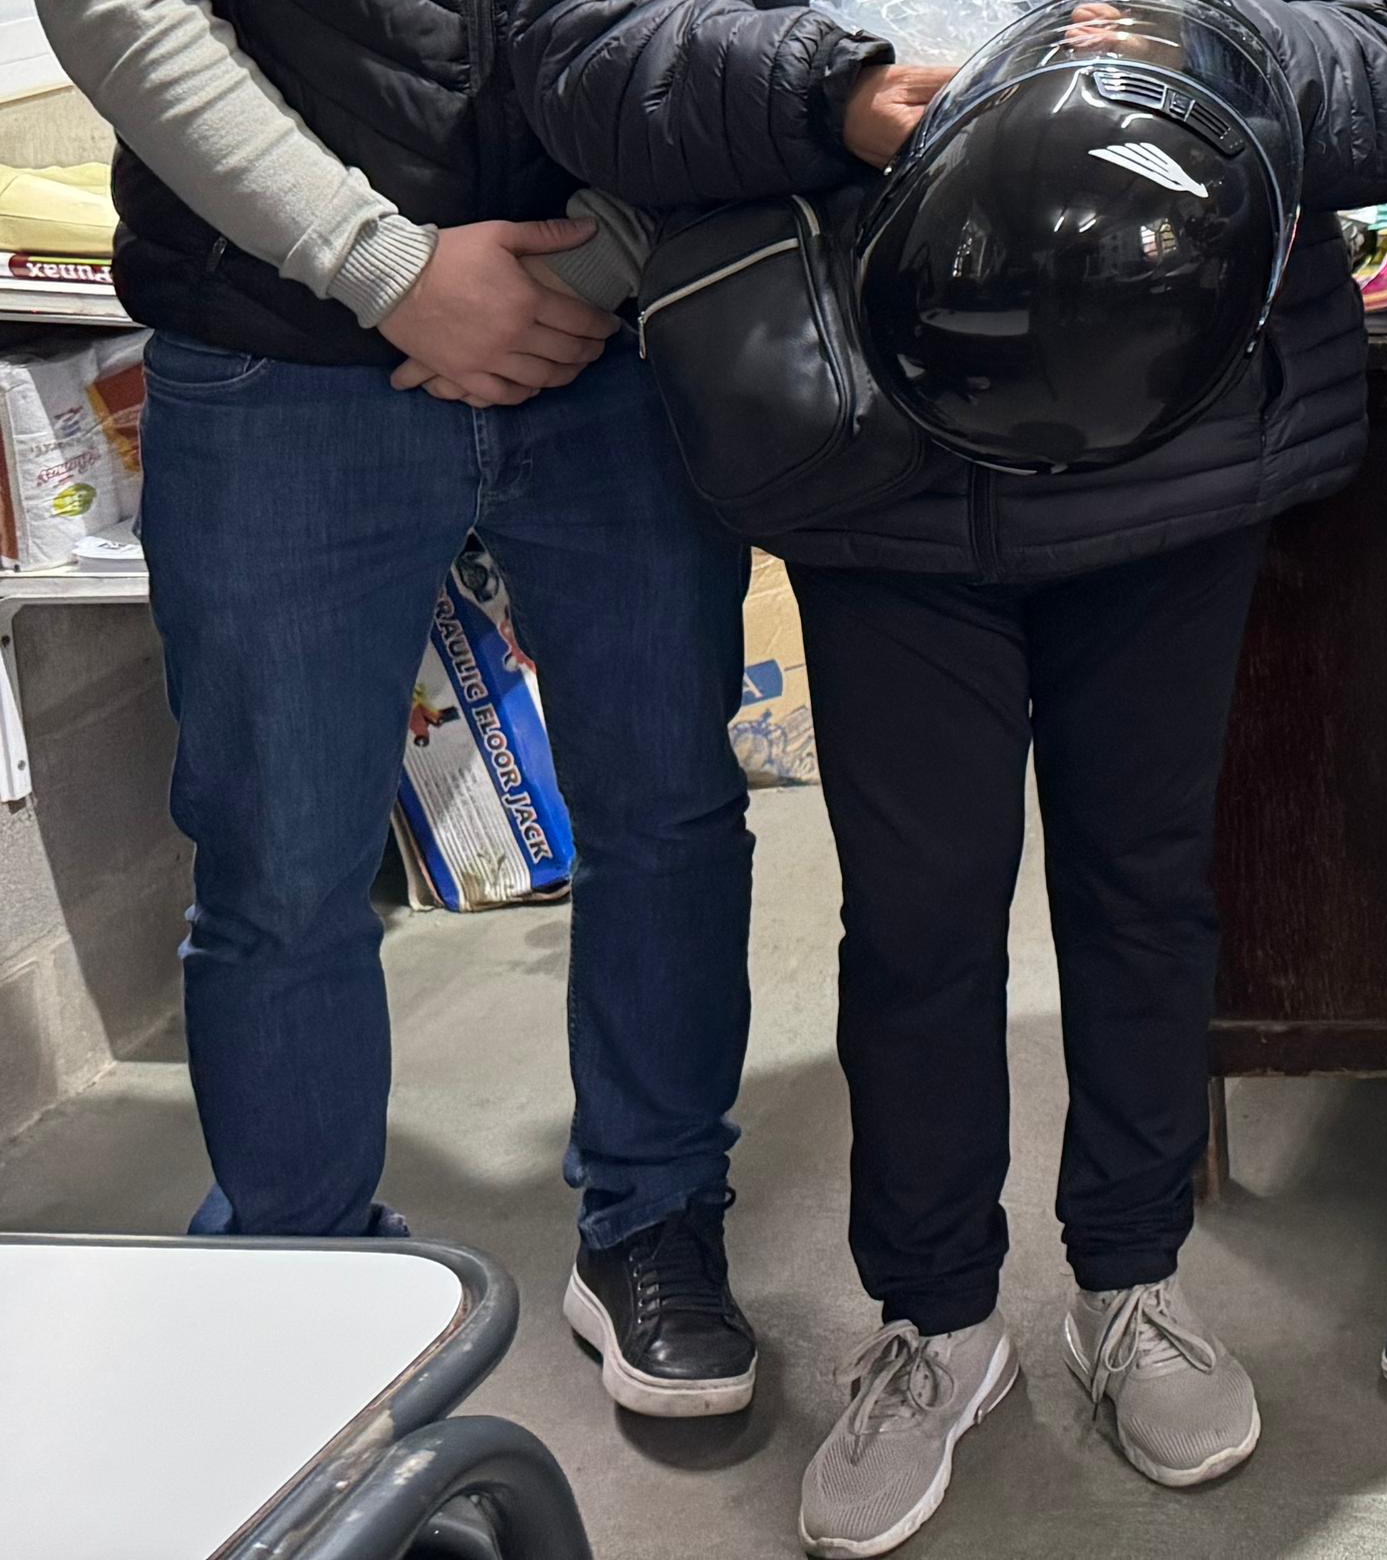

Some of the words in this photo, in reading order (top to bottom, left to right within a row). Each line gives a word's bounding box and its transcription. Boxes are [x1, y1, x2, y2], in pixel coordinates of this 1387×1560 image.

[433, 592, 490, 702] RAULIC
[472, 702, 522, 792] FLOOR
[502, 792, 553, 865] JACK
